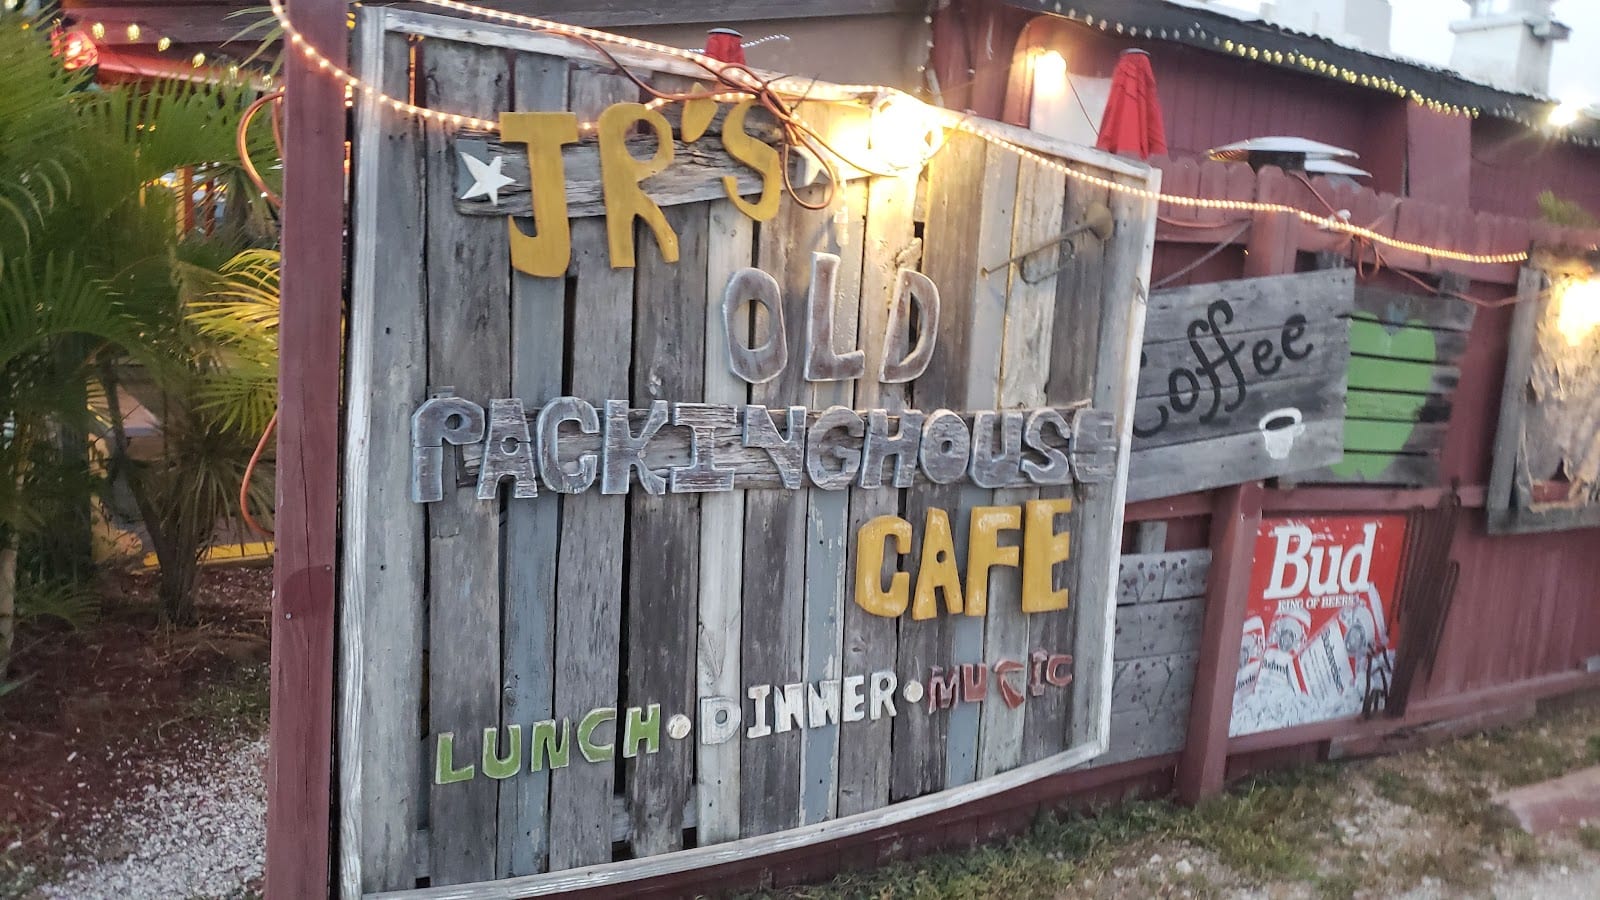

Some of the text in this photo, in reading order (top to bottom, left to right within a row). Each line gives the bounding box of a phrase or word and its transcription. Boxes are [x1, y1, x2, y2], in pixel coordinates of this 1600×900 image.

[500, 83, 783, 278] JR'S
[722, 251, 941, 384] OLD
[411, 395, 1117, 503] PACKINGHOUSE
[855, 498, 1073, 620] CAFE
[1263, 522, 1377, 599] Bud
[1278, 597, 1304, 612] KING
[1306, 596, 1320, 609] OF
[434, 702, 661, 785] LUNCH
[701, 670, 898, 746] DINNER
